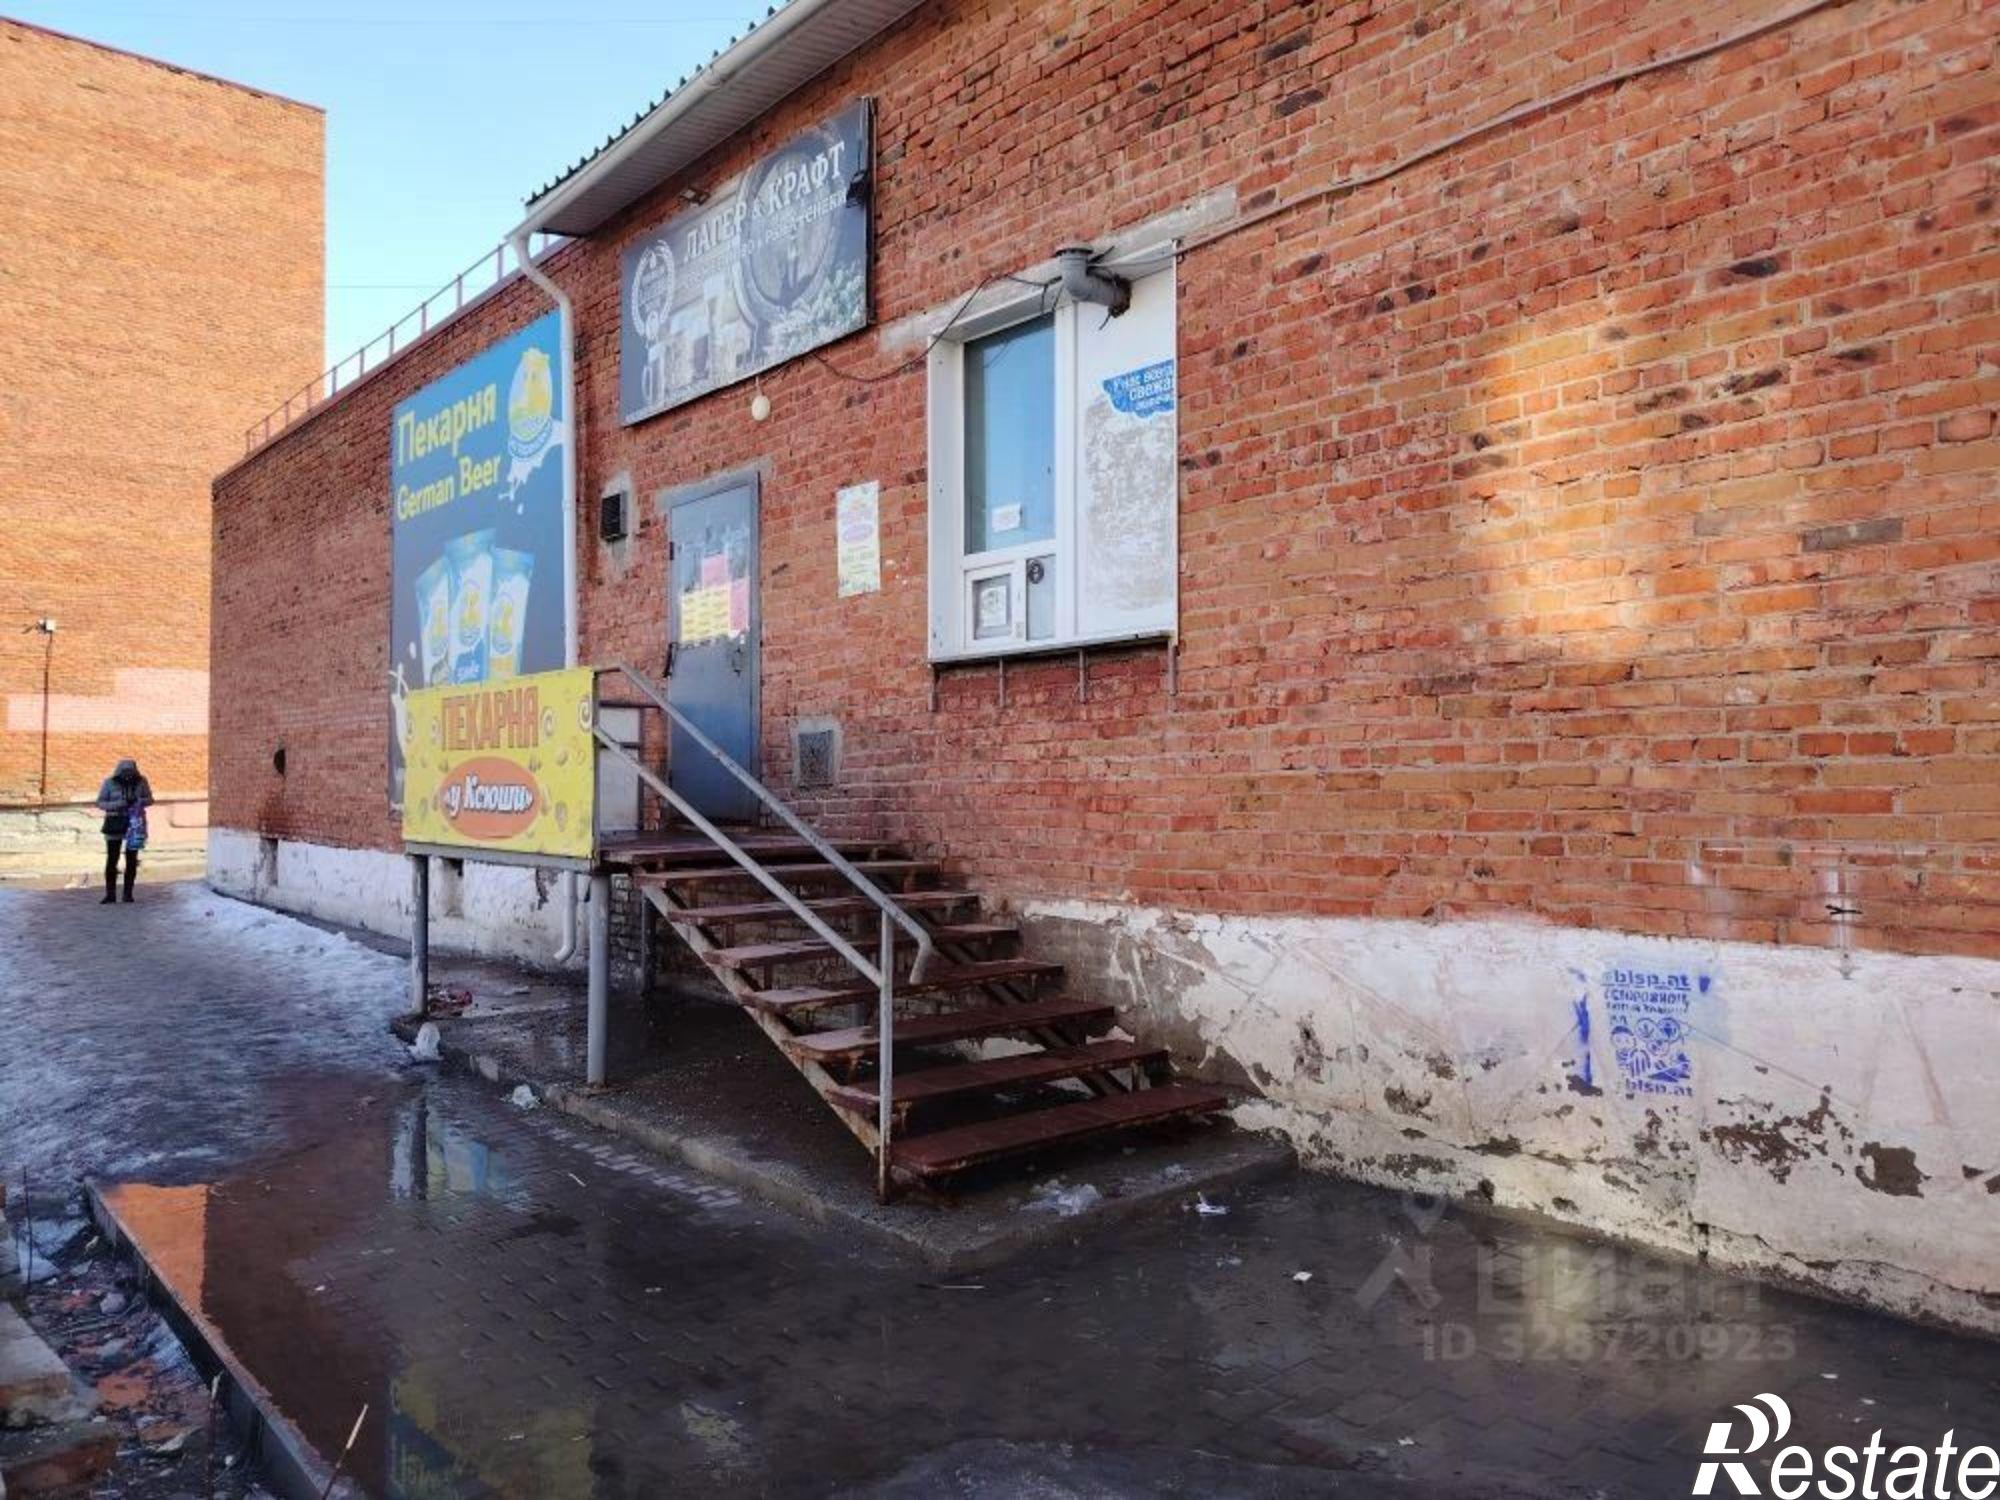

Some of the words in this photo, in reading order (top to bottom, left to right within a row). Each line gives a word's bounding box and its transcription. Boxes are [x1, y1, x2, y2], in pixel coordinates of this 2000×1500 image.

[684, 201, 748, 262] ЛАГЕР
[766, 141, 845, 217] КРАФТ
[398, 383, 497, 467] Пекарня
[396, 474, 455, 521] German
[458, 454, 501, 497] Beer
[441, 685, 540, 752] ПЕКАРНЯ
